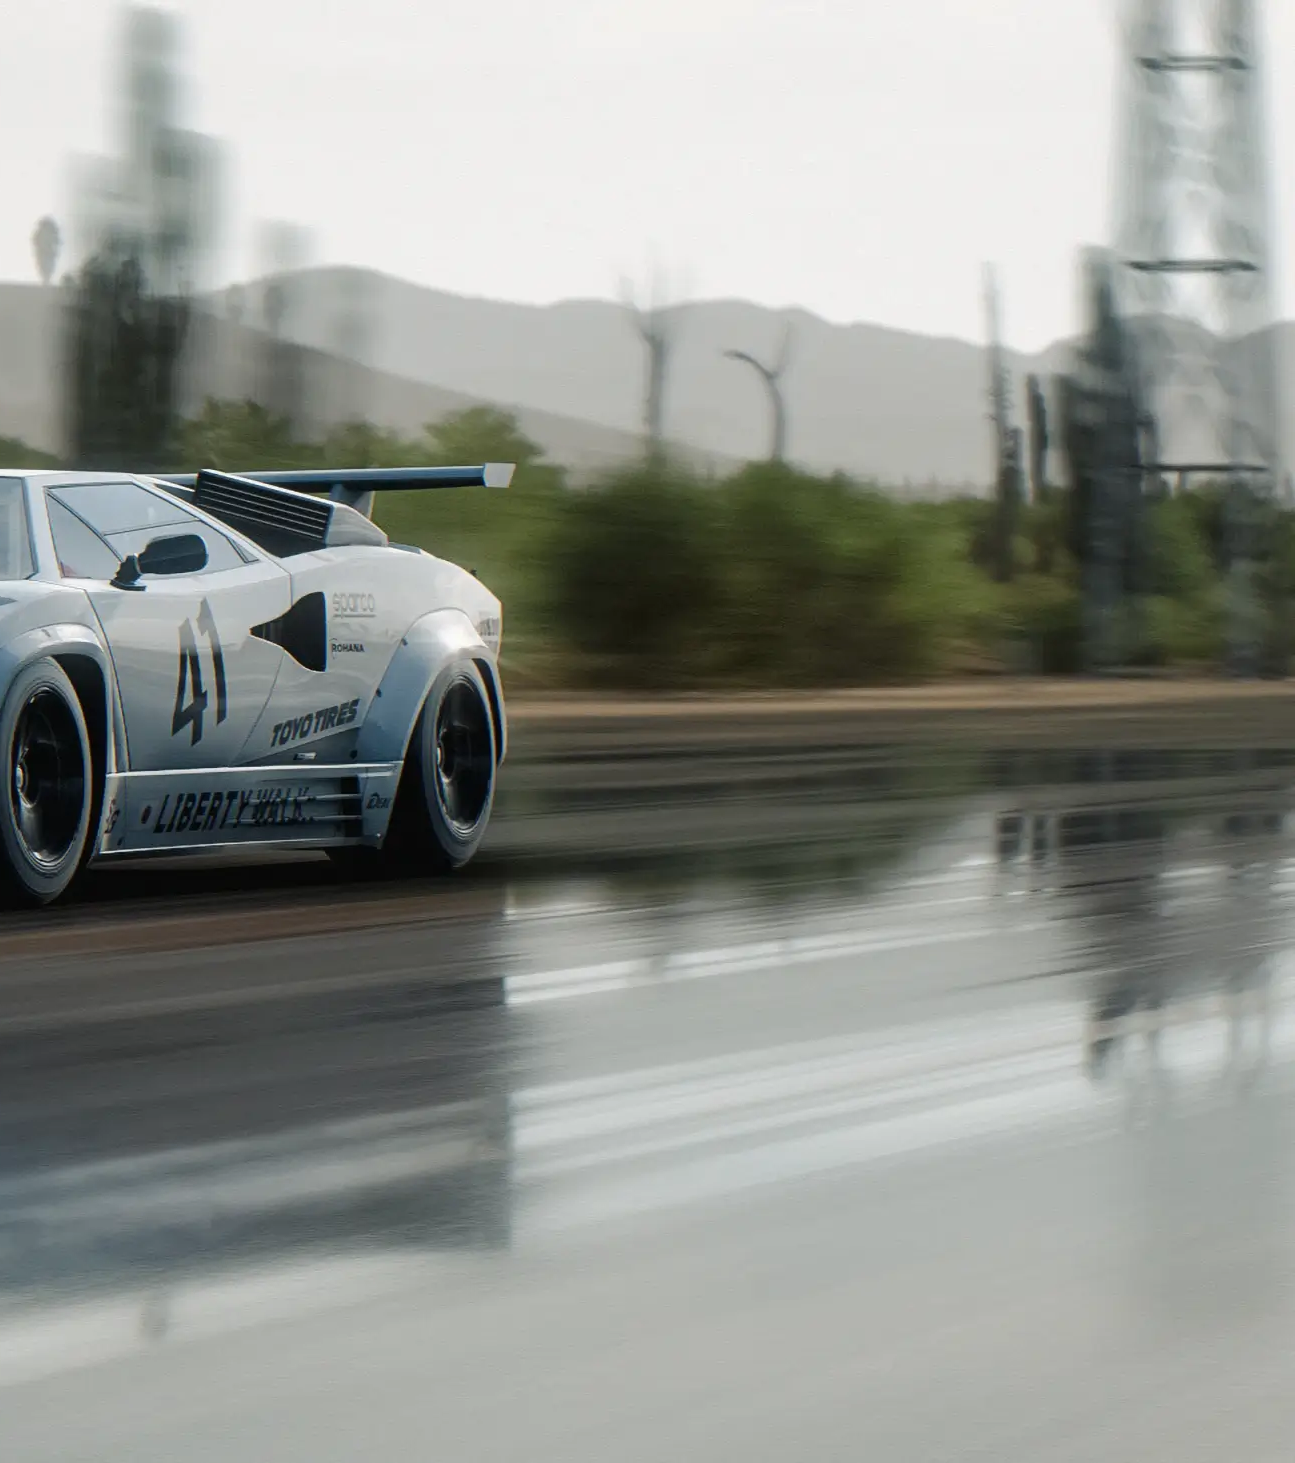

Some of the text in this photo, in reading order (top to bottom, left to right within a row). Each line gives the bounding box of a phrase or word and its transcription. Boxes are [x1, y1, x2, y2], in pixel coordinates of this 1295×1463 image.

[332, 592, 375, 618] sparco
[331, 642, 365, 653] ROHANA
[171, 597, 227, 746] 41
[271, 699, 360, 747] TOYO TIRES
[153, 790, 253, 833] LIBERTY
